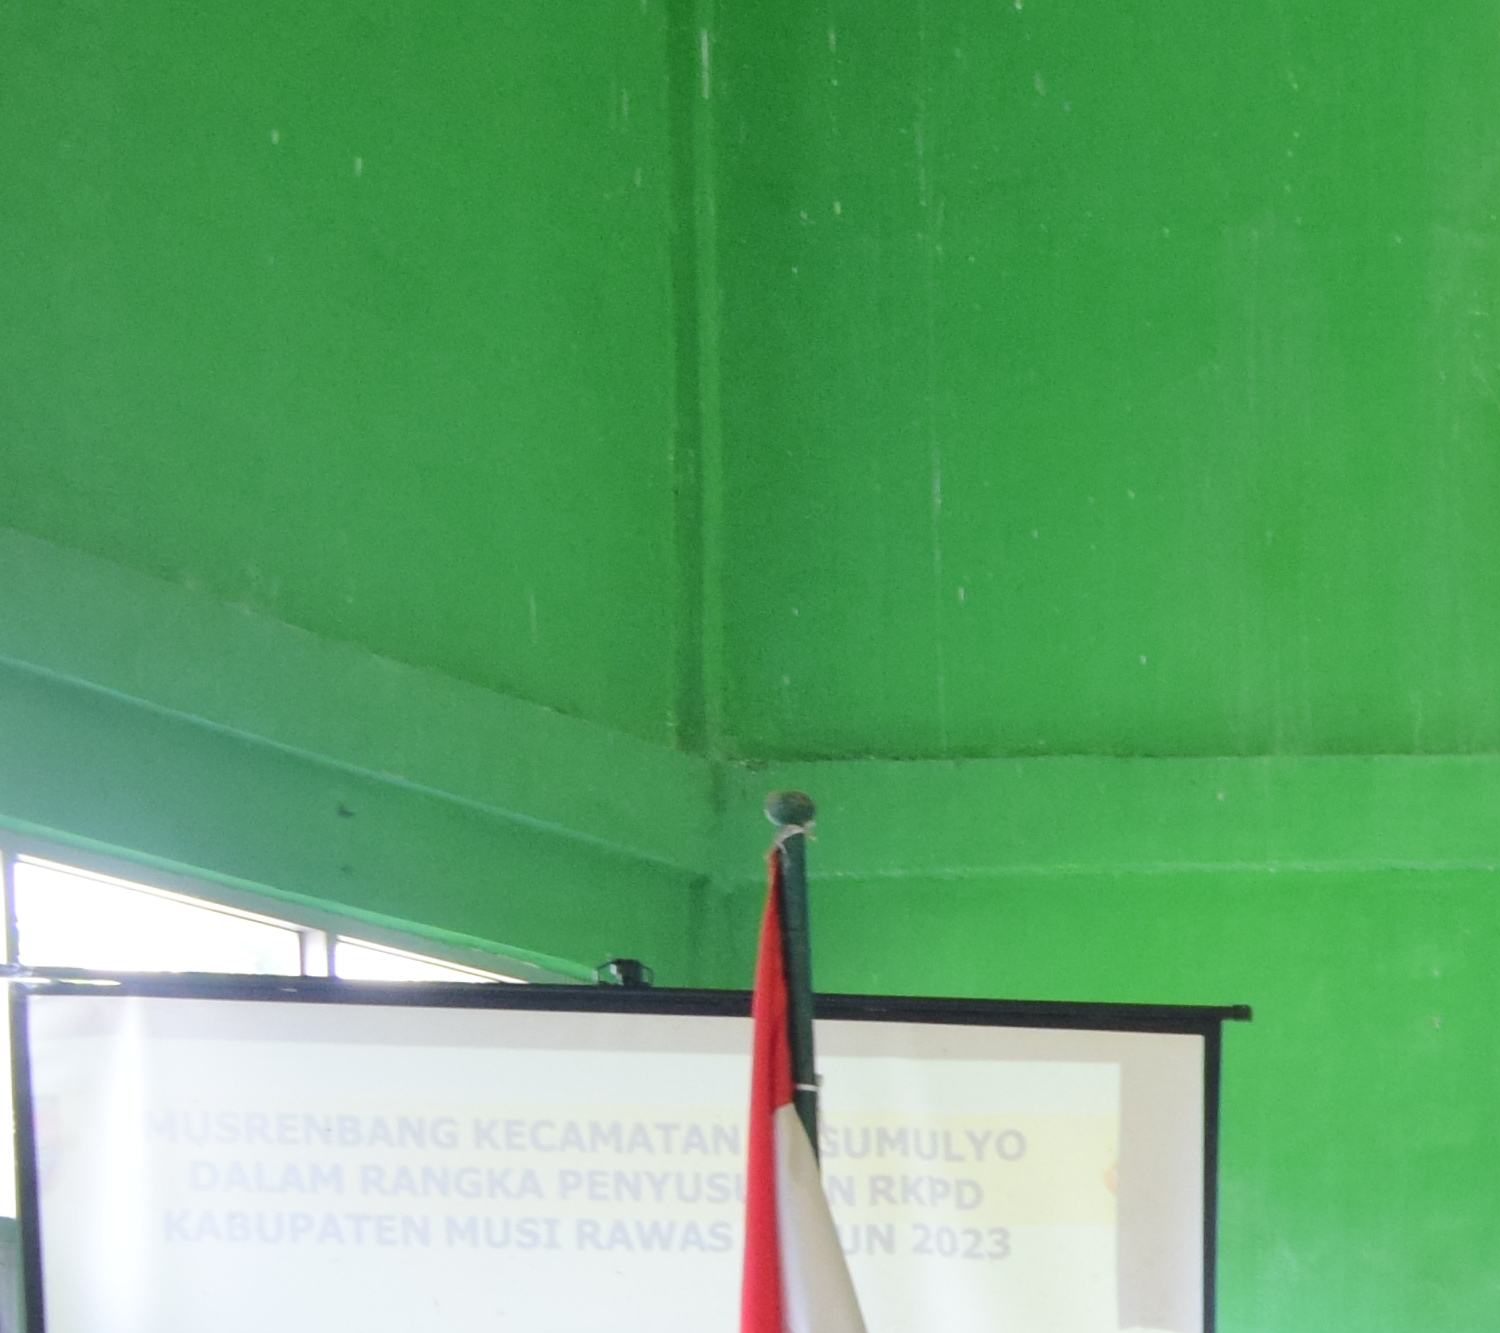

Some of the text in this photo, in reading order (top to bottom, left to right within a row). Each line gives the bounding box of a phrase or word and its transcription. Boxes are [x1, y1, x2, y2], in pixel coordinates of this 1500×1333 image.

[147, 1110, 1028, 1162] MUSRENBANG KECAMATAN GUMULYO
[189, 1160, 344, 1196] DALAM
[360, 1164, 545, 1200] RANGKA
[868, 1173, 984, 1211] RKPD
[162, 1209, 432, 1248] KABUPATEN
[445, 1215, 563, 1251] MUSI
[575, 1218, 734, 1253] RAWAS
[911, 1222, 1012, 1260] 2023
